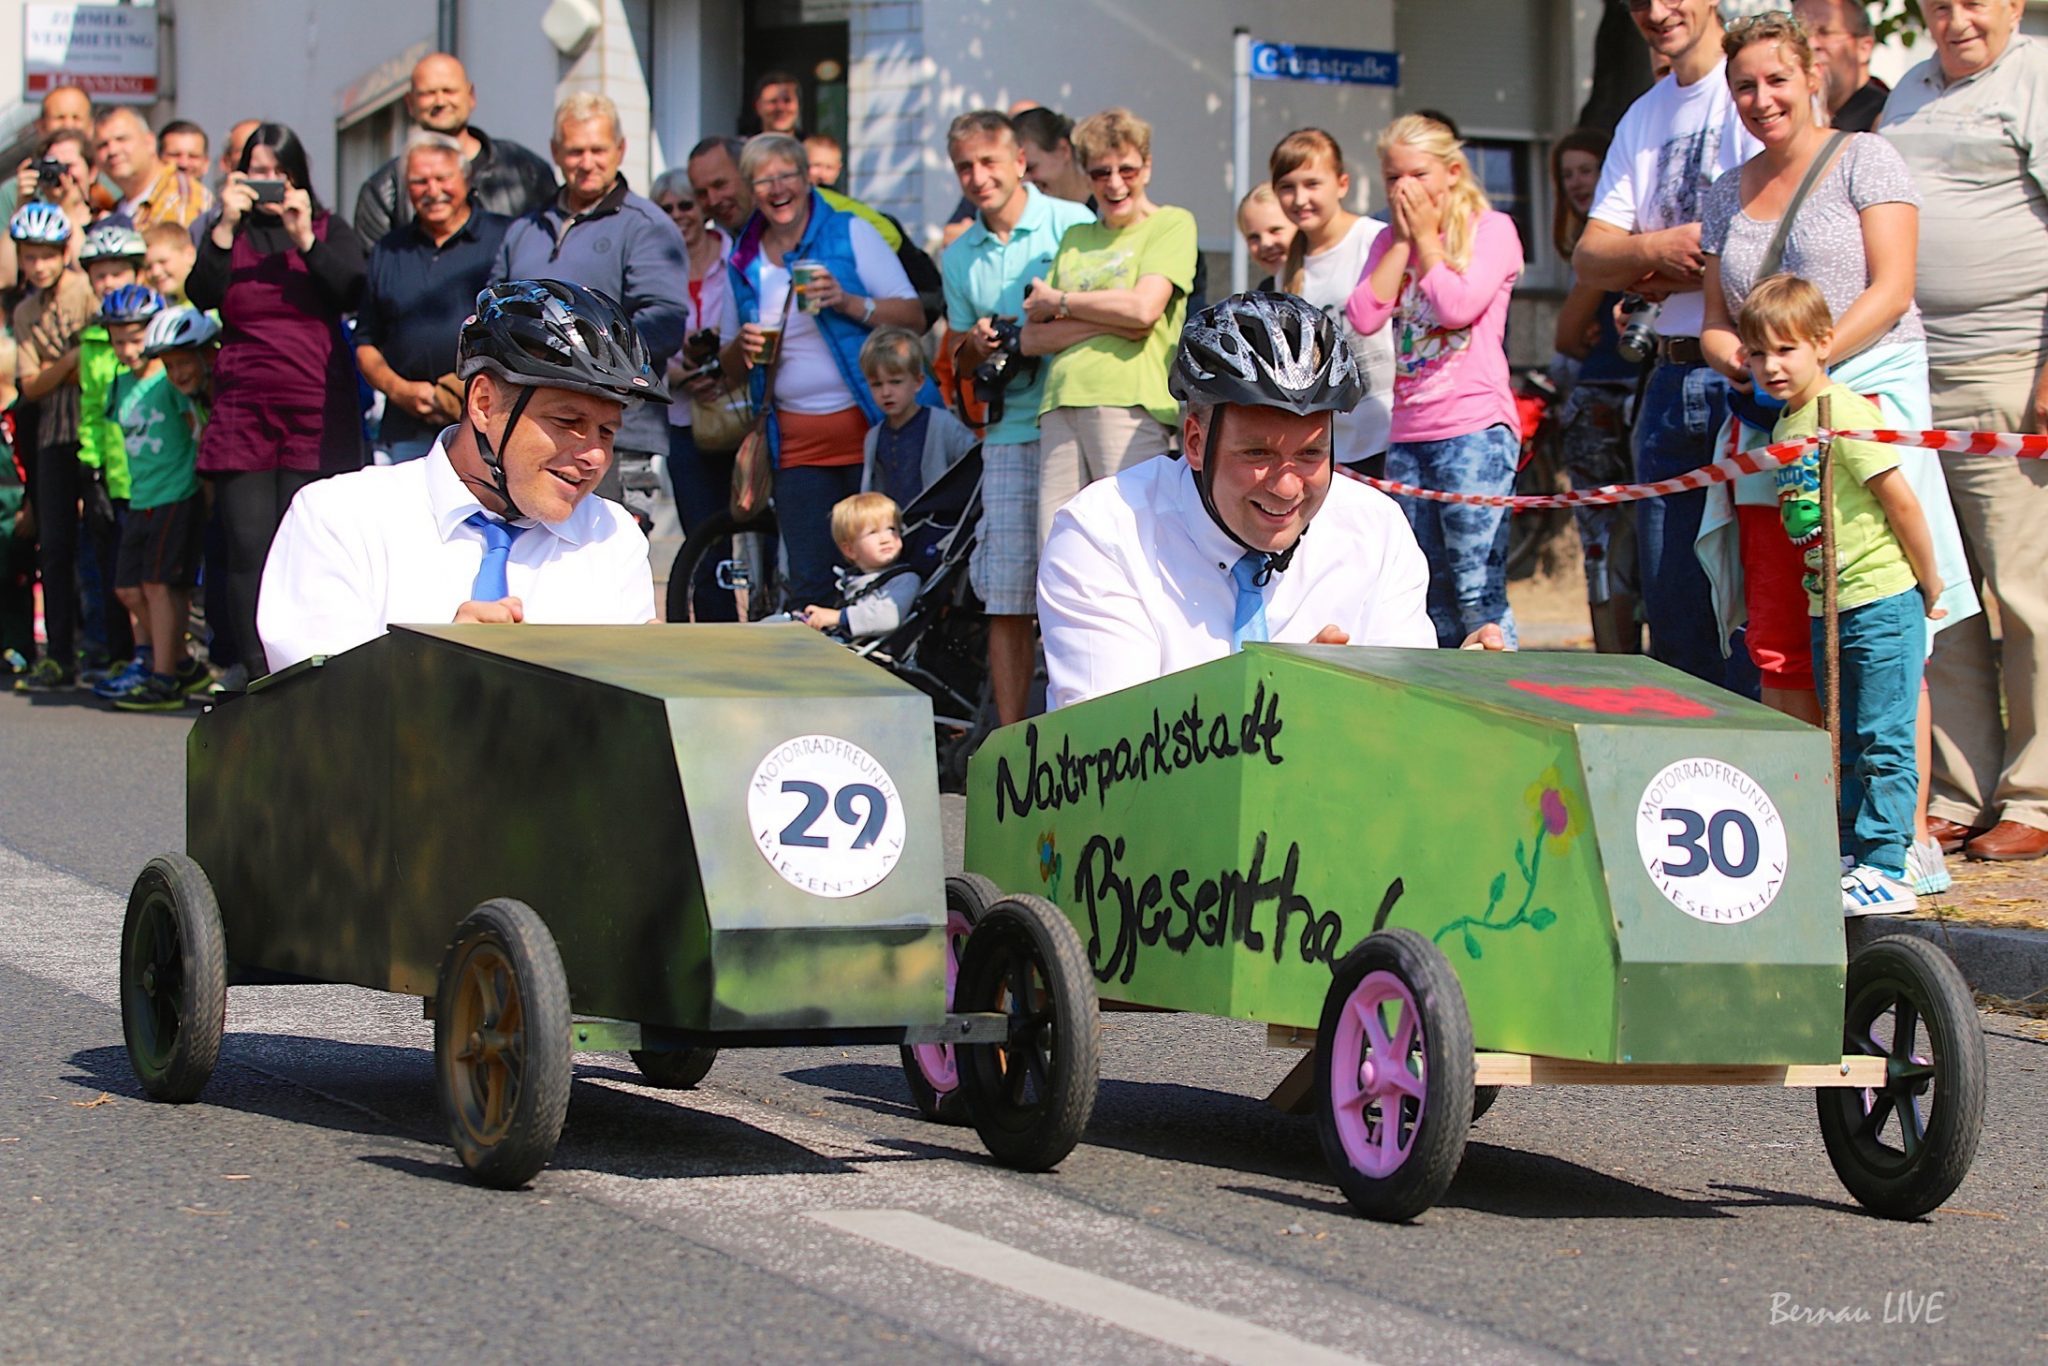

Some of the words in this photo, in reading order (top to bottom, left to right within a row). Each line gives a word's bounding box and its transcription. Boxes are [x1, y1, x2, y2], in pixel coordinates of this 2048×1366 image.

[1257, 47, 1391, 79] Grünstraße
[755, 738, 897, 802] MOTORRADFREUNDE
[1641, 762, 1777, 827] MOTORRADFREUNDE
[779, 780, 888, 850] 29
[1661, 808, 1760, 879] 30
[1650, 858, 1784, 919] BIESENTHAL
